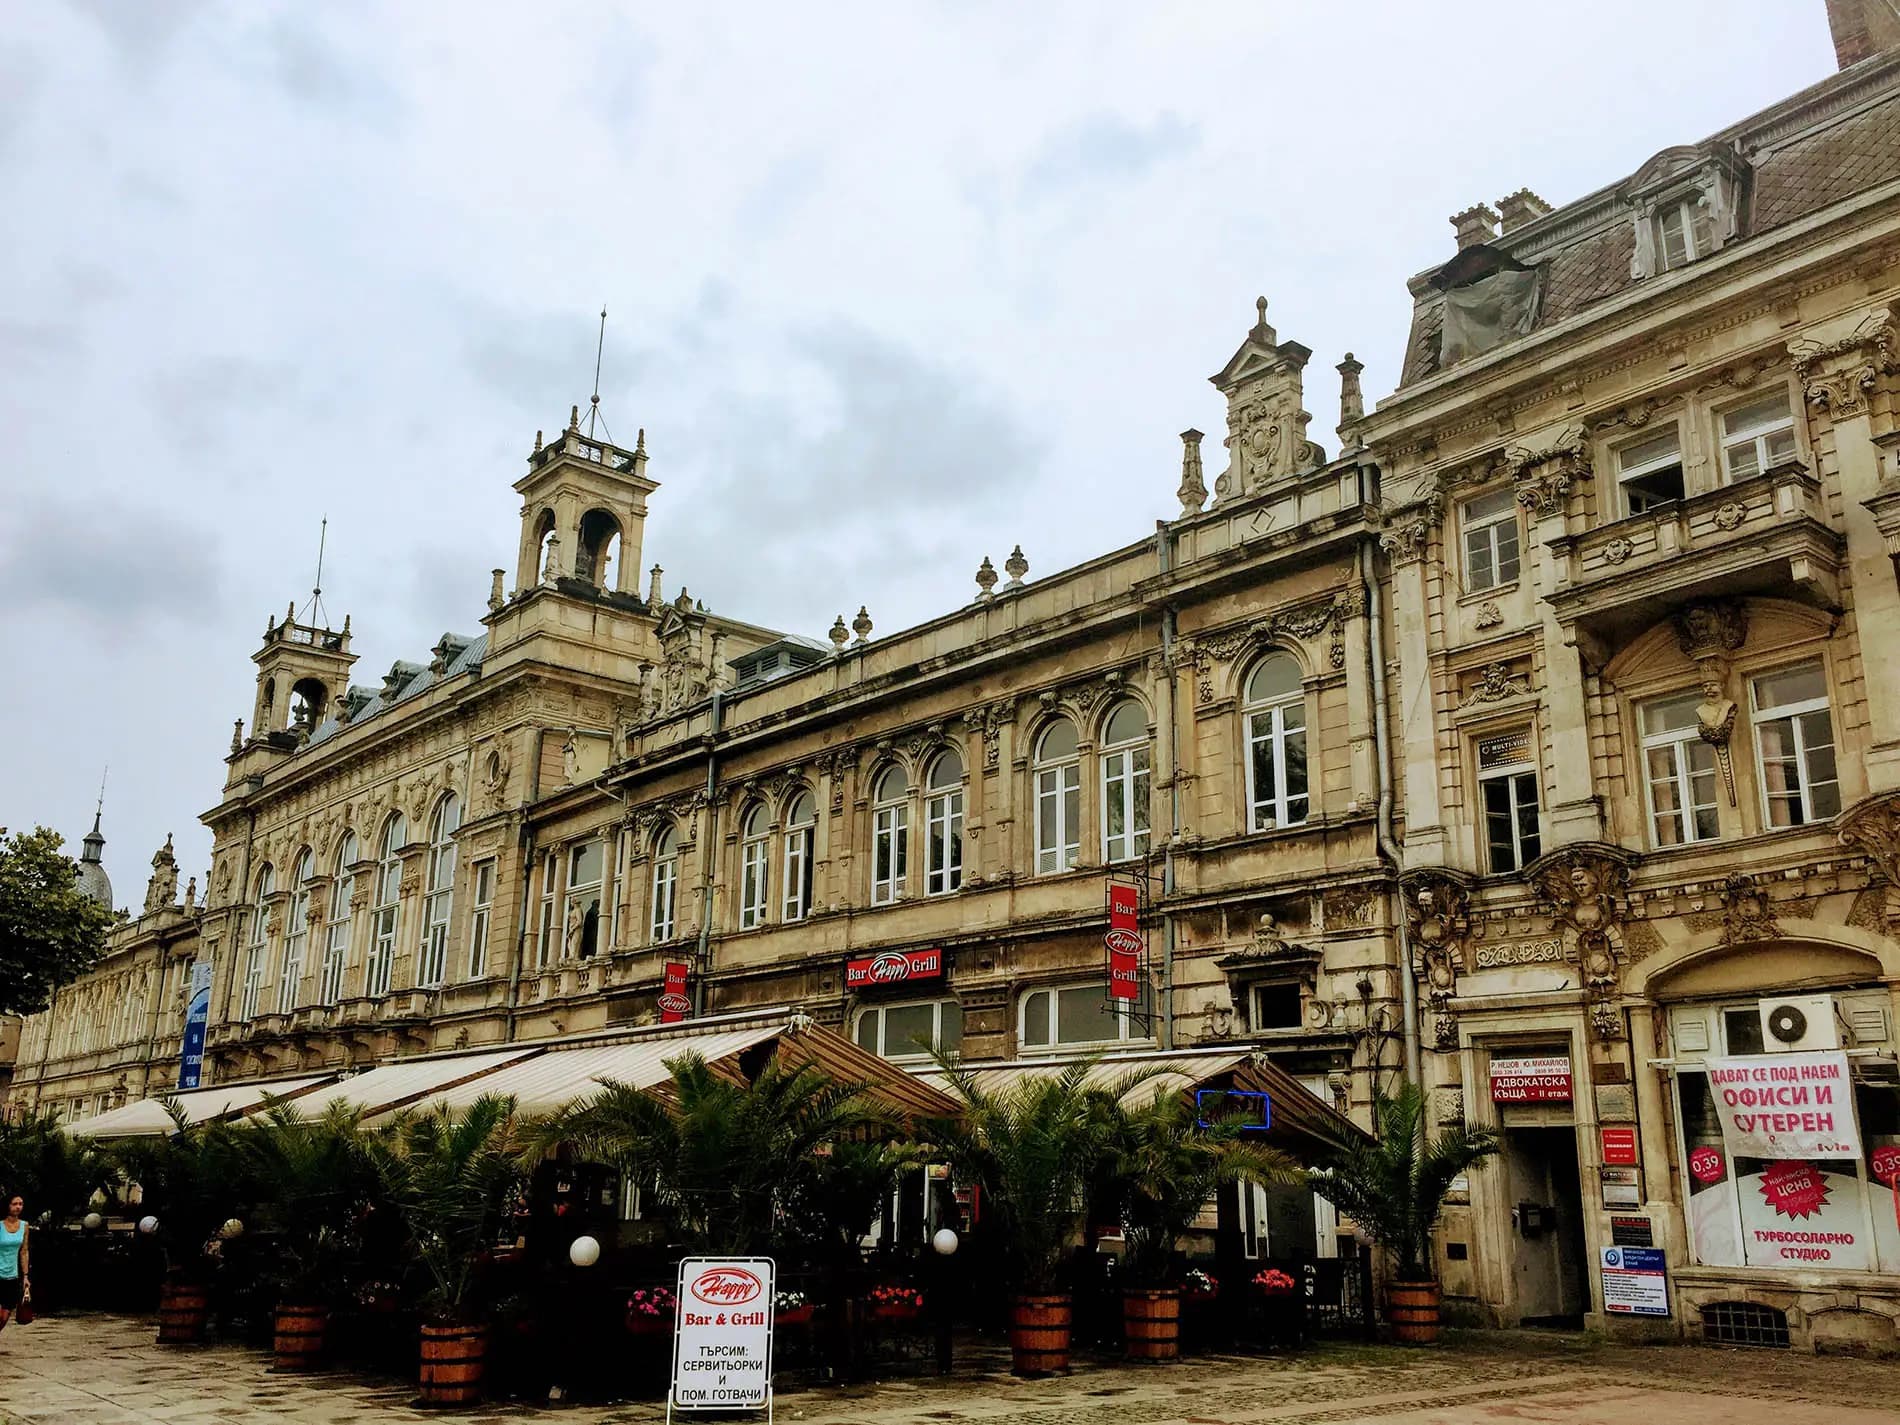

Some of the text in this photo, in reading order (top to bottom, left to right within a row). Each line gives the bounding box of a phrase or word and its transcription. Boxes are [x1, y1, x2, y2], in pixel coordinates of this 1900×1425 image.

[1115, 901, 1135, 915] Bar
[1110, 932, 1139, 953] Happy
[848, 956, 937, 981] Bar Happy Grill
[1113, 968, 1137, 982] Grill
[669, 974, 686, 984] Bar
[1711, 1064, 1840, 1086] ДАВАТ СЕ ПОД НАЕМ
[1496, 1077, 1568, 1088] АДВОКАТСКА
[1494, 1089, 1527, 1099] КЪЩА
[1723, 1085, 1834, 1107] ОФИСИ И
[1733, 1111, 1834, 1133] СУТЕРЕН
[1692, 1155, 1719, 1173] 0,39
[1776, 1177, 1813, 1196] цена
[1754, 1230, 1855, 1245] ТУРБОСОЛАРНО
[1780, 1247, 1832, 1261] СТУДИО
[699, 1275, 756, 1300] Happy
[685, 1311, 764, 1326] Bar & Grill
[700, 1346, 748, 1357] ТЪРСИМ:
[683, 1360, 762, 1372] СЕРВИТЬОРКИ
[718, 1375, 727, 1385] И
[682, 1389, 761, 1400] ПОМ. ГОТВАЧИ
